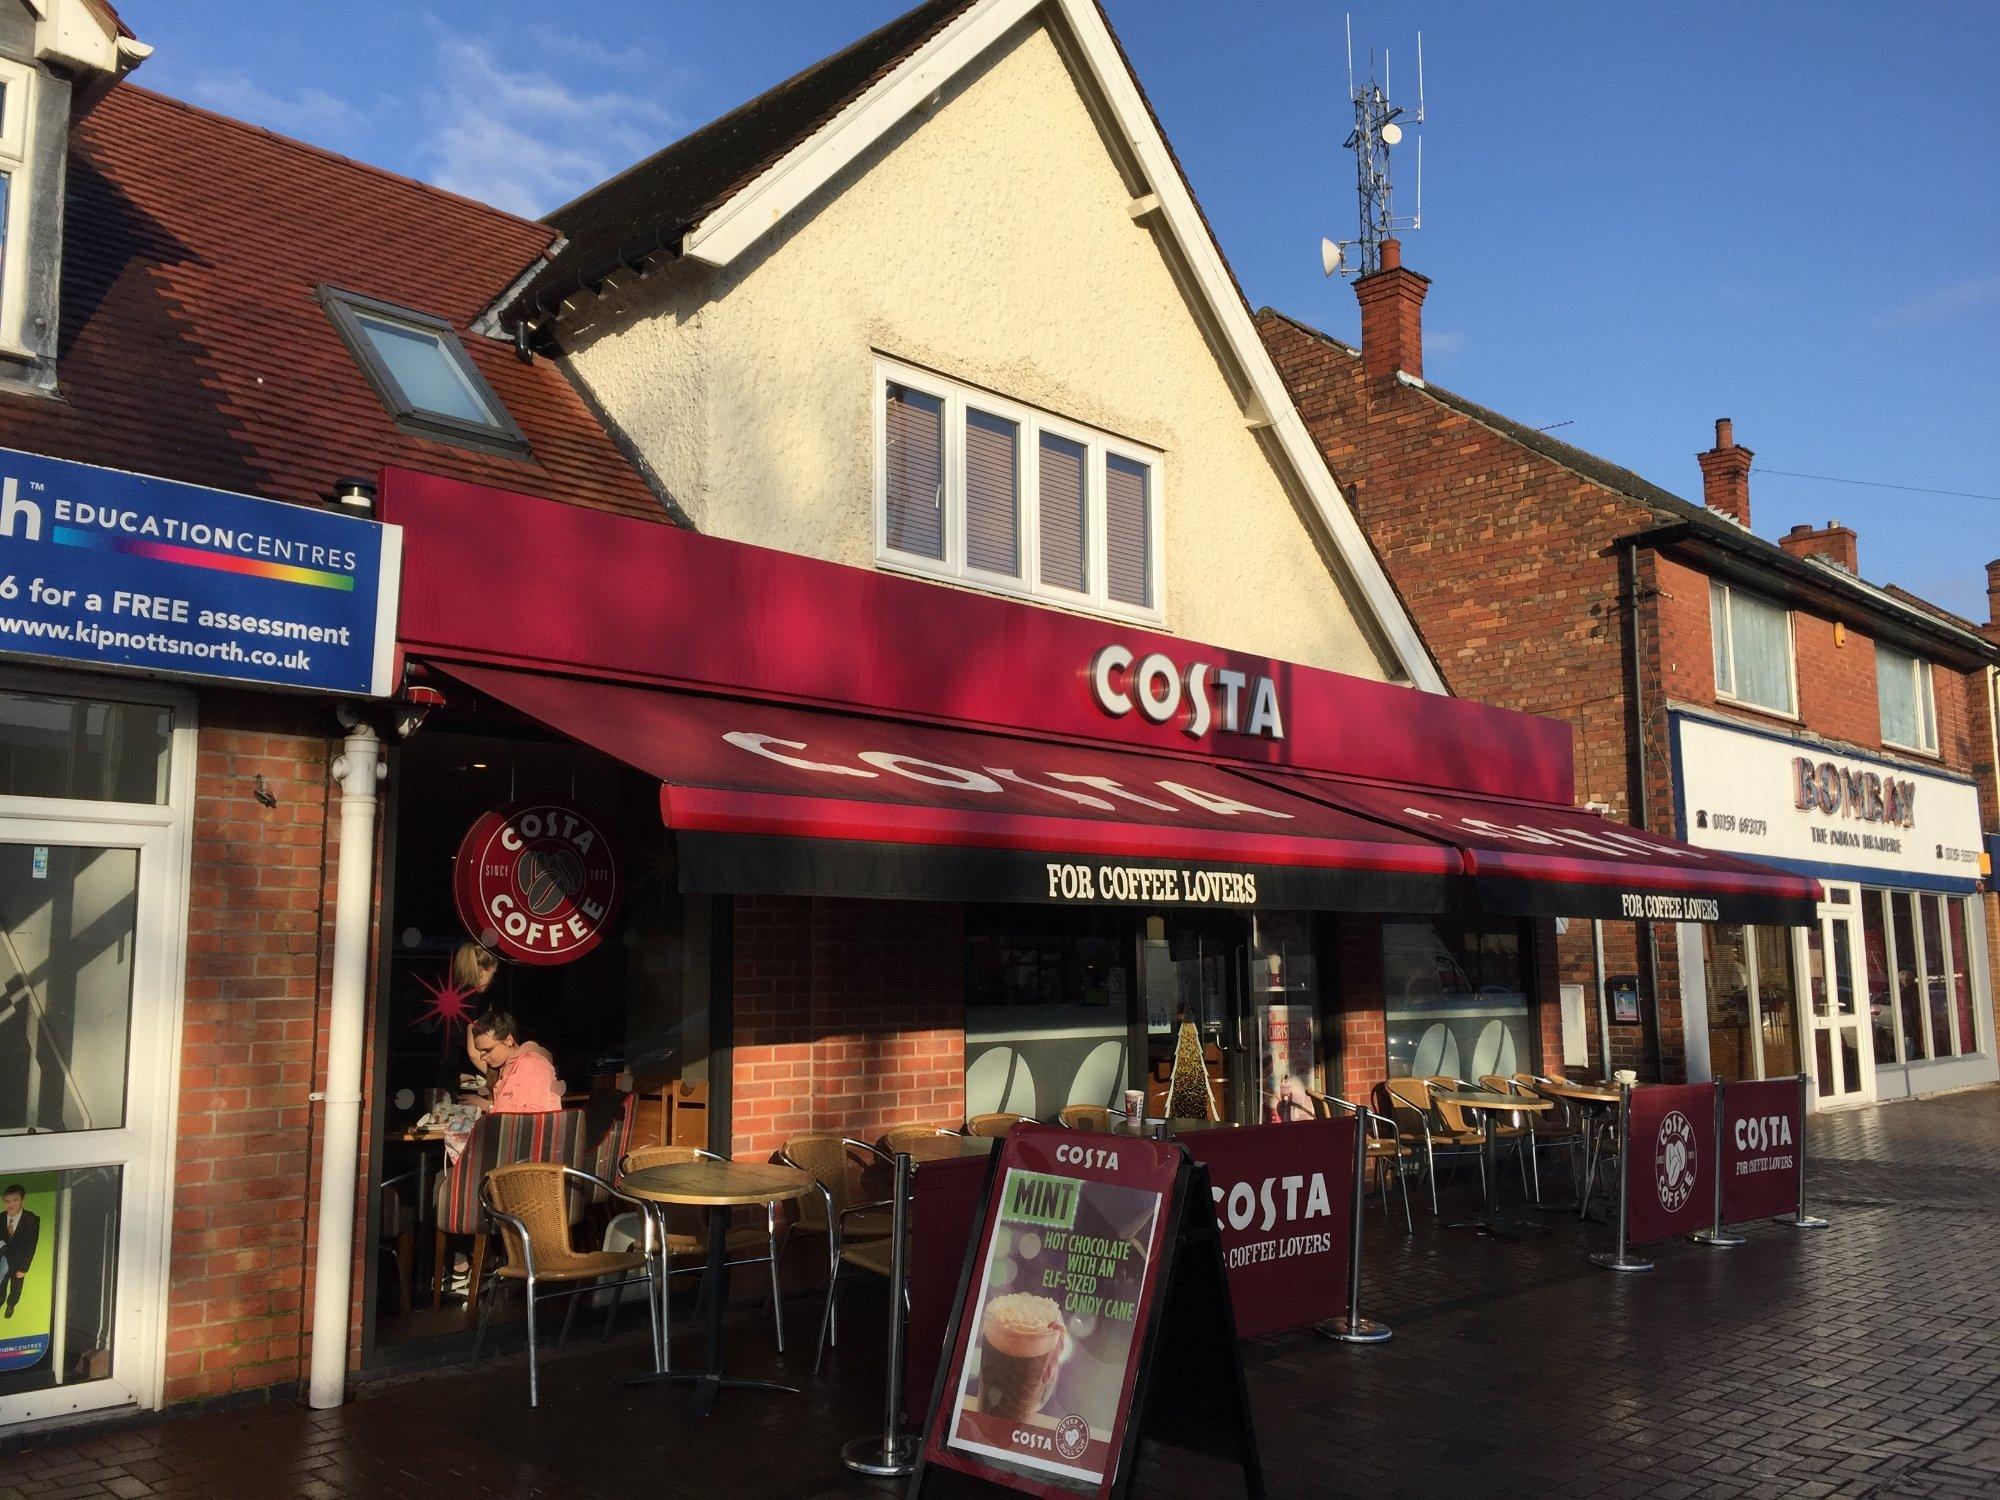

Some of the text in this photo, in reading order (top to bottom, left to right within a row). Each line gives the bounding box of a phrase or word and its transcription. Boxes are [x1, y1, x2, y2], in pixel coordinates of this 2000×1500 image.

[29, 577, 76, 607] for
[84, 593, 102, 612] a
[112, 591, 189, 624] FREE
[198, 606, 350, 646] assessment
[0, 617, 311, 671] www.kipnottsnorth.co.uk
[1090, 643, 1284, 740] COSTA
[722, 730, 1296, 819] COSTA
[1792, 756, 1917, 829] BOMBAY
[501, 811, 597, 855] COSTA
[1402, 807, 1710, 859] COSTA
[1810, 826, 1828, 844] THE
[485, 865, 509, 877] SINCE
[1047, 863, 1257, 903] FOR COFFEE LOVERS
[491, 894, 604, 948] COFFEE
[1621, 894, 1720, 921] FOR COFFEE LOVERS
[1661, 1114, 1690, 1146] COSTA
[1735, 1115, 1793, 1152] COSTA
[1055, 1144, 1119, 1171] COSTA
[1736, 1155, 1793, 1176] FOR COFFEE LOVERS
[1012, 1177, 1075, 1220] MINT
[1659, 1170, 1694, 1208] COFFEE
[1043, 1231, 1132, 1261] HOT CHOCOLATE
[1229, 1240, 1277, 1269] COFFEE
[1279, 1232, 1331, 1259] LOVERS
[1041, 1269, 1097, 1295] ELF-SIZED
[1067, 1253, 1117, 1278] WITH AN
[1064, 1292, 1136, 1321] CANDY CANE
[1012, 1430, 1052, 1450] COSTA
[1059, 1418, 1079, 1434] NEVER
[1075, 1438, 1086, 1453] CUP
